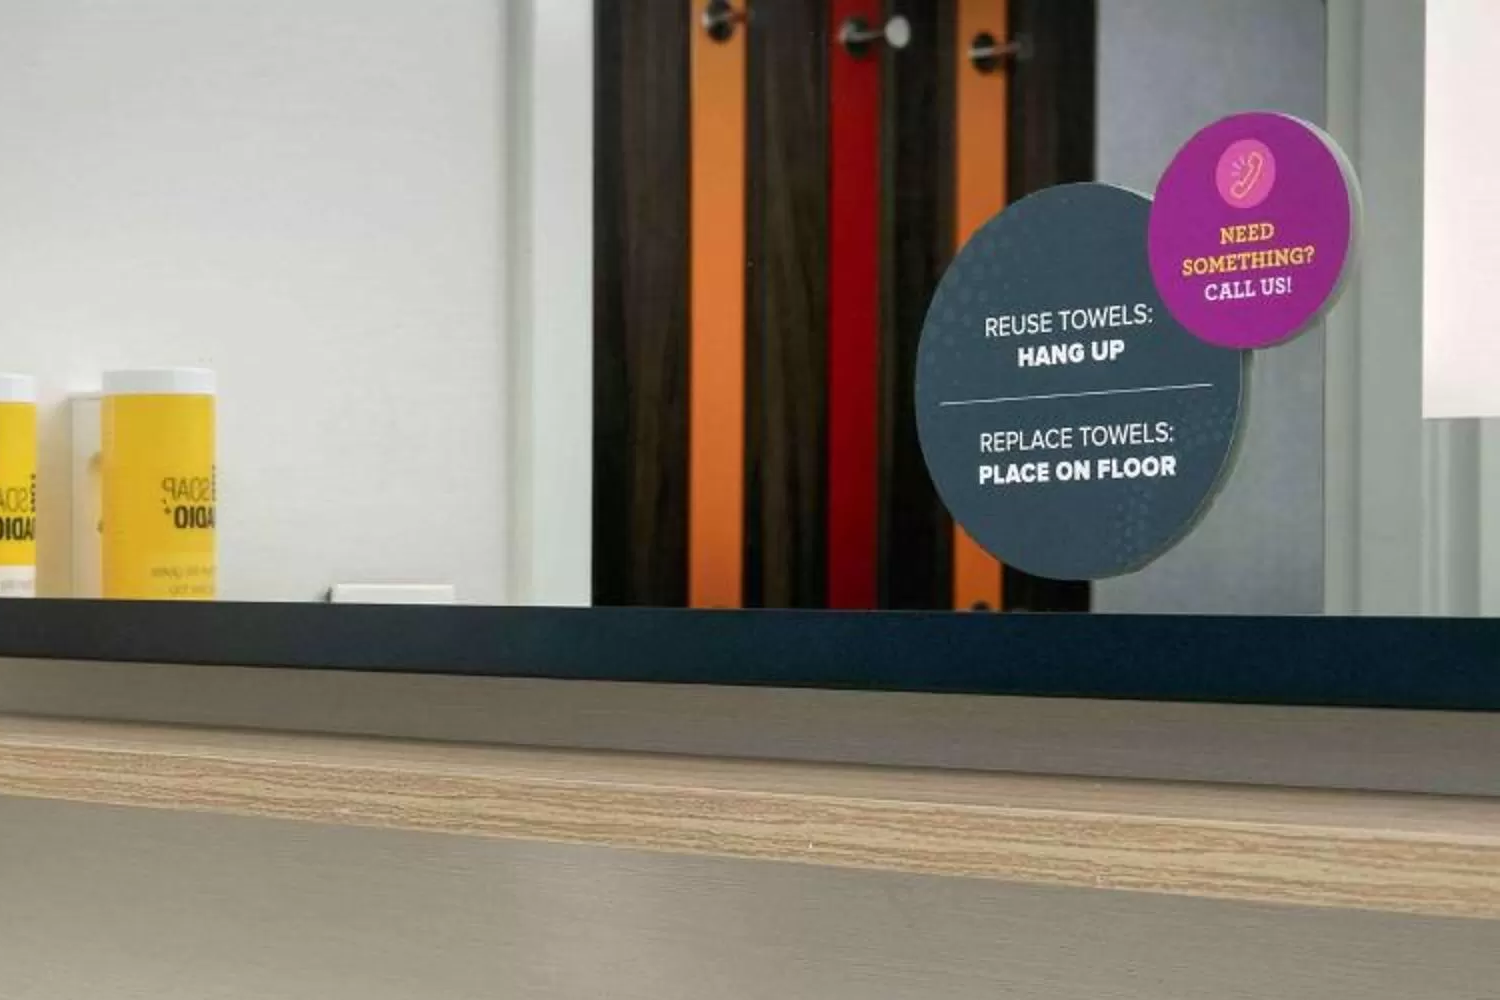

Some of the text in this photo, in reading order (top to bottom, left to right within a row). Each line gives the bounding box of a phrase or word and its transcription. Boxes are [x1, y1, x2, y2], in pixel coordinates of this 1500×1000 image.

[1220, 223, 1274, 244] NEED
[1182, 245, 1315, 276] SOMETHING?
[1204, 276, 1292, 301] CALL US!
[985, 303, 1153, 337] REUSE TOWELS:
[1017, 339, 1125, 367] HANG UP
[980, 421, 1175, 453] REPLACE TOWELS:
[979, 455, 1177, 485] PLACE ON FLOOR
